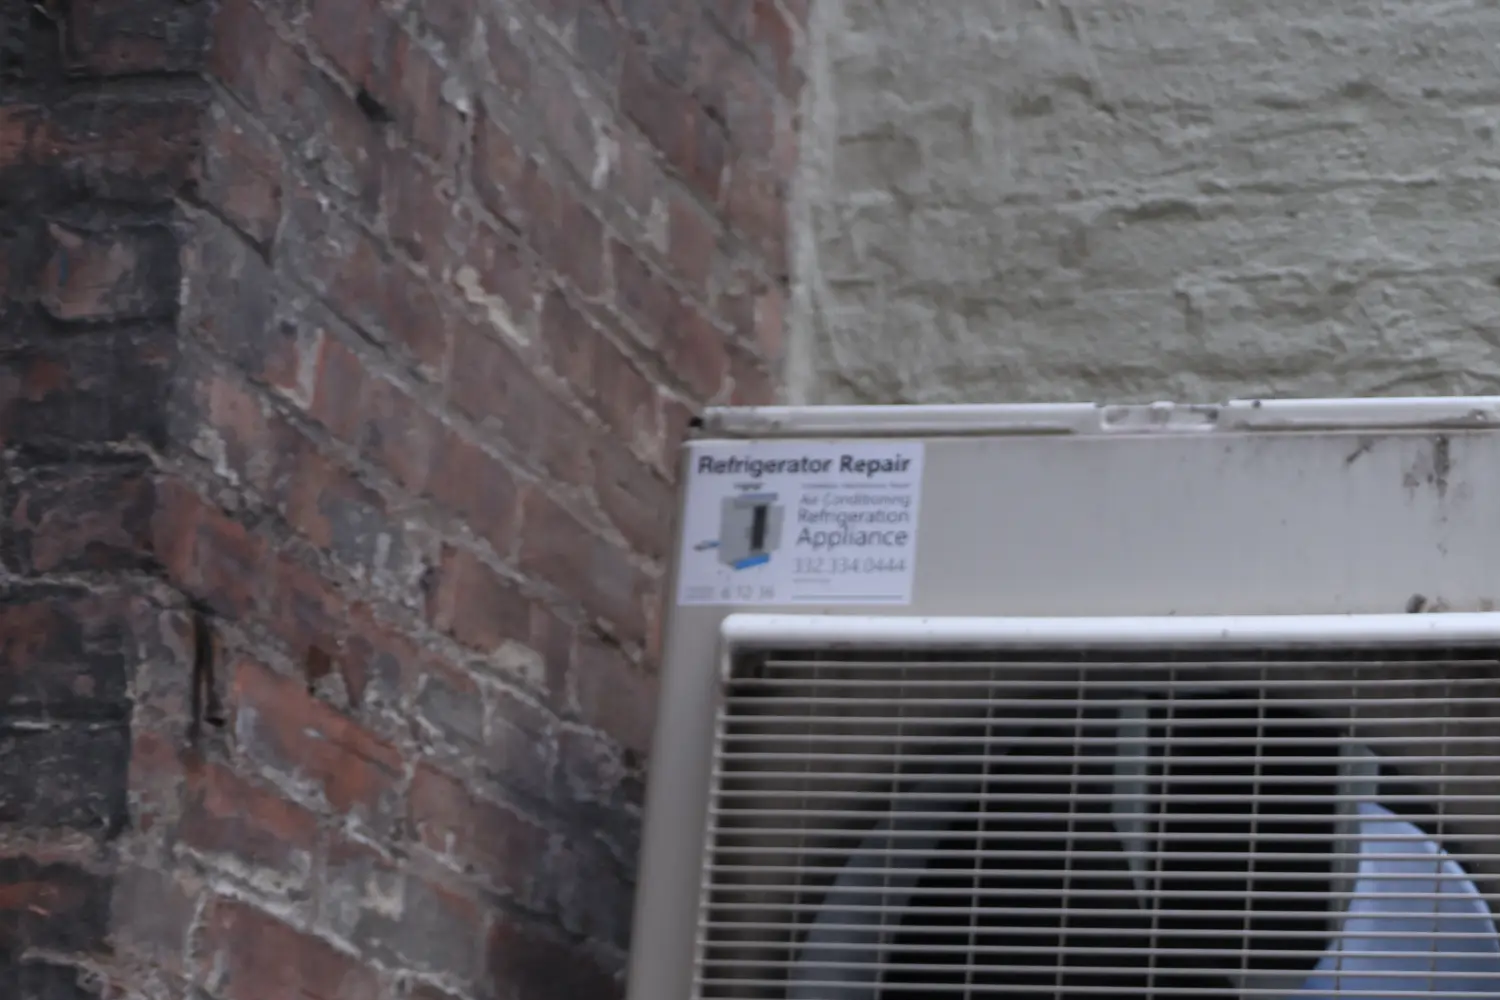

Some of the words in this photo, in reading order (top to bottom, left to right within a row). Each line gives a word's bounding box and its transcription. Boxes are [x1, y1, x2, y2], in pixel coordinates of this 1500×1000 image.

[698, 455, 832, 478] Refrigerator
[839, 453, 911, 478] Repair
[798, 508, 910, 527] Refrigeration
[796, 526, 909, 550] Appliance
